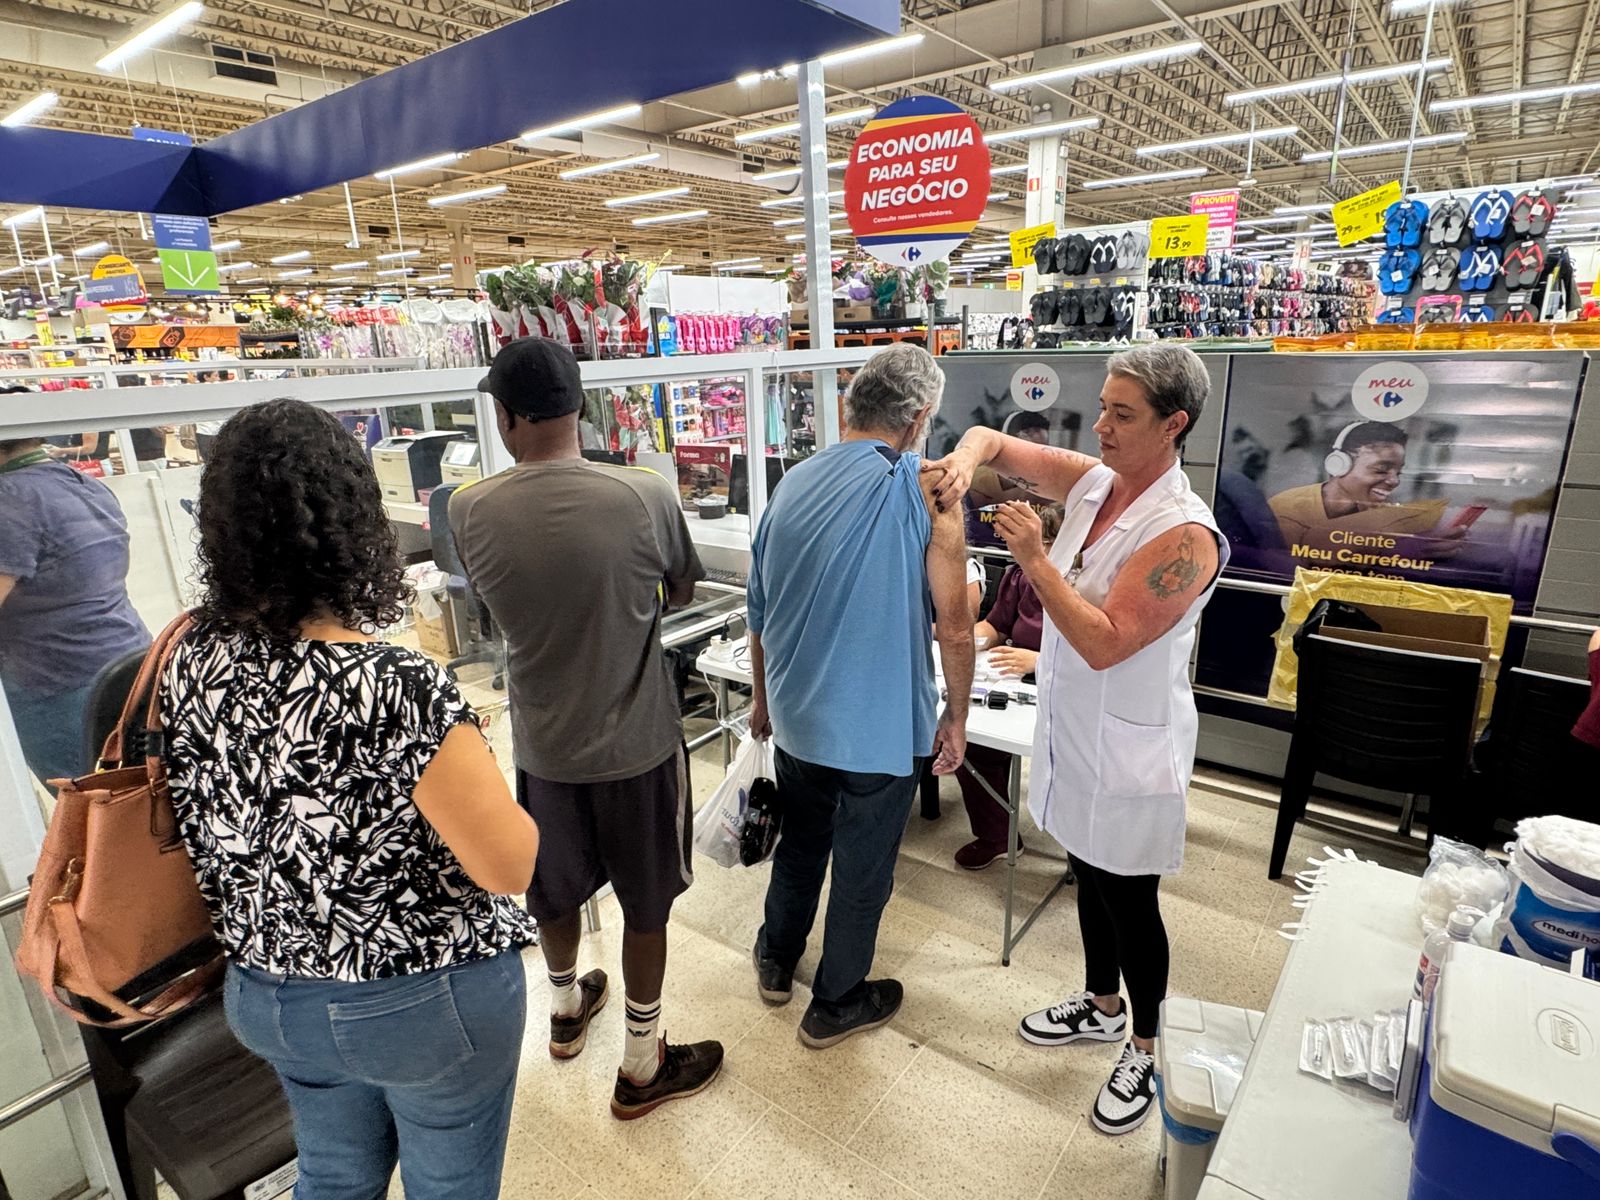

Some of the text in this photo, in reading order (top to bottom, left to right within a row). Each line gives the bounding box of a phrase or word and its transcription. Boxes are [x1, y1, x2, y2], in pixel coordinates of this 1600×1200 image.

[857, 127, 974, 163] ECONOMIA
[868, 154, 958, 183] PARA SEU
[860, 178, 969, 211] NEGÓCIO
[1194, 194, 1236, 206] APROVEITE
[873, 215, 897, 224] Consulte
[898, 213, 917, 221] nossos
[1020, 375, 1051, 385] meu
[1368, 377, 1415, 389] meu
[1329, 530, 1396, 549] Cliente
[1291, 543, 1434, 571] Meu Carrefour
[1542, 921, 1580, 939] medi
